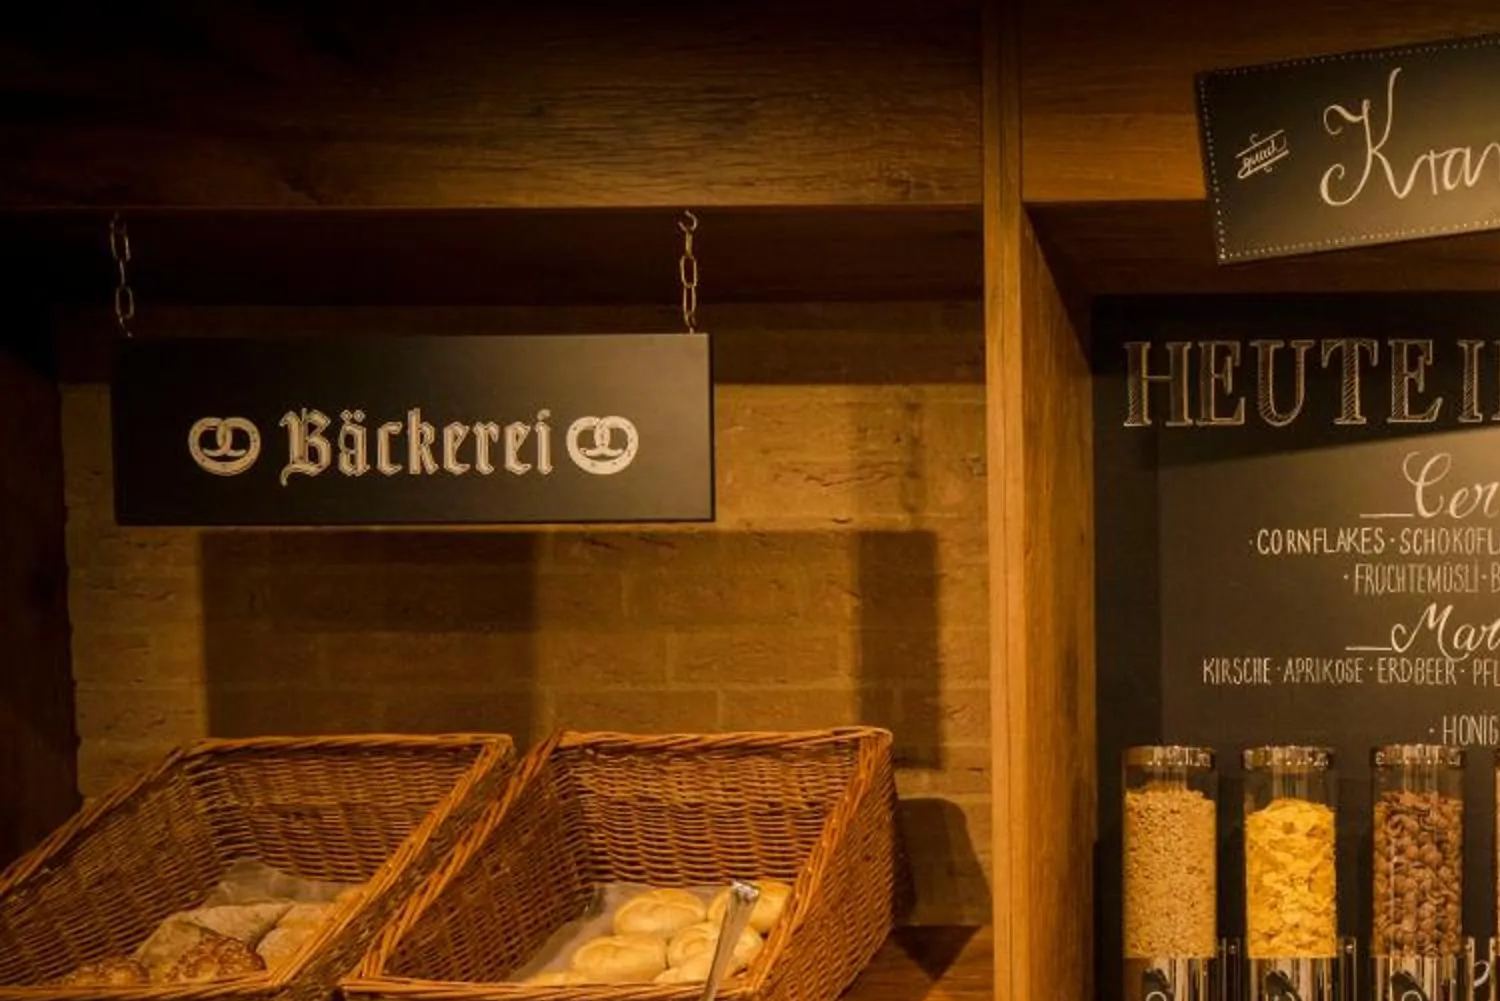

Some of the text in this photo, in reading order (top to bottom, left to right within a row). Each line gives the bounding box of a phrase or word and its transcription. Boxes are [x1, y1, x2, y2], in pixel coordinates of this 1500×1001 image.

[1123, 338, 1444, 428] HEUTE
[279, 407, 553, 487] Bäckerei
[1256, 526, 1387, 556] CORNFLAKES
[1202, 656, 1272, 686] KIRSCHE
[1283, 656, 1365, 686] APRIKOSE
[1376, 657, 1458, 686] ERDBEER
[1442, 714, 1500, 746] HONIG
